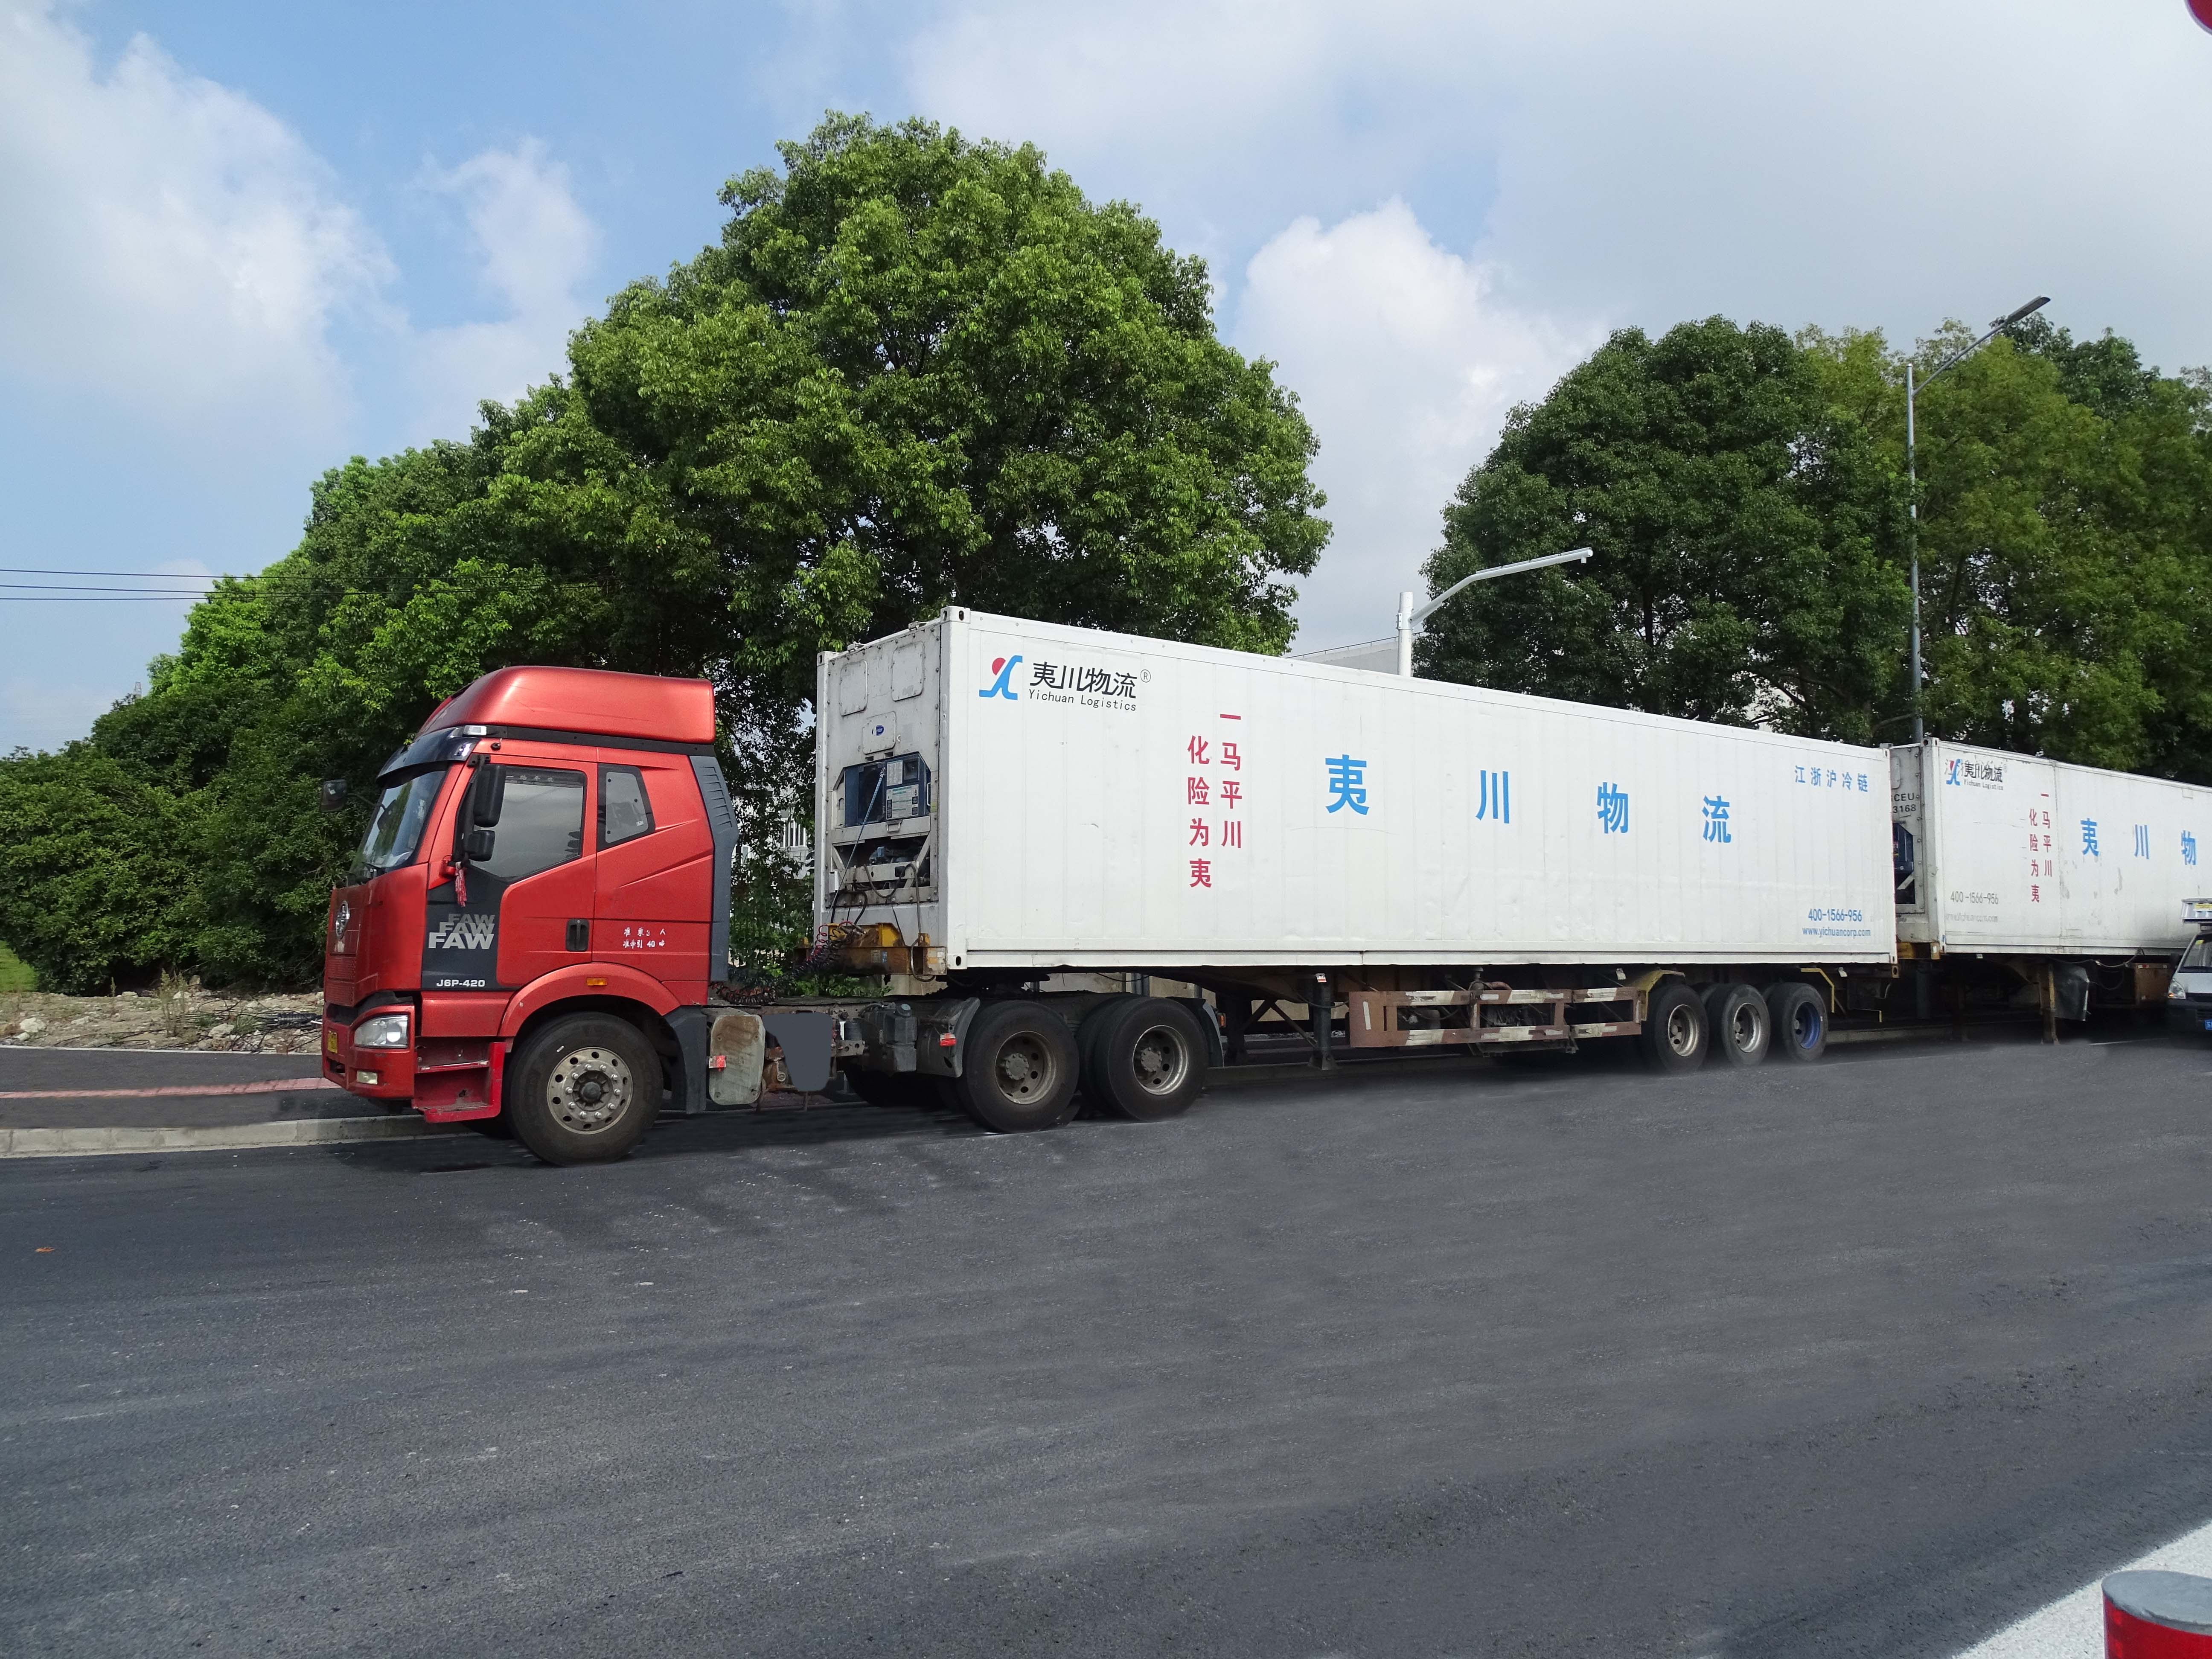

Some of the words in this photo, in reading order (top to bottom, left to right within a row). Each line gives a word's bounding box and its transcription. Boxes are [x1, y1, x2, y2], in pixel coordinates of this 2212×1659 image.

[1030, 661, 1137, 699] 夷川物流
[1029, 689, 1074, 703] Yichuan
[1081, 695, 1136, 711] Logistics
[1220, 714, 1242, 848] 一马平川
[1795, 765, 1868, 792] 江浙沪冷链
[1187, 735, 1212, 888] 化险为夷
[1325, 754, 1731, 843] 夷川物流
[2041, 794, 2052, 877] 一马平川
[2080, 818, 2196, 865] 夷川物
[2029, 809, 2039, 902] 化险为夷
[1950, 891, 1999, 904] 400-1566-956
[439, 922, 495, 936] FAW
[1808, 908, 1862, 922] 400-1566-956
[428, 932, 494, 949] FAW
[1802, 927, 1871, 938] www.yichuancorp.com
